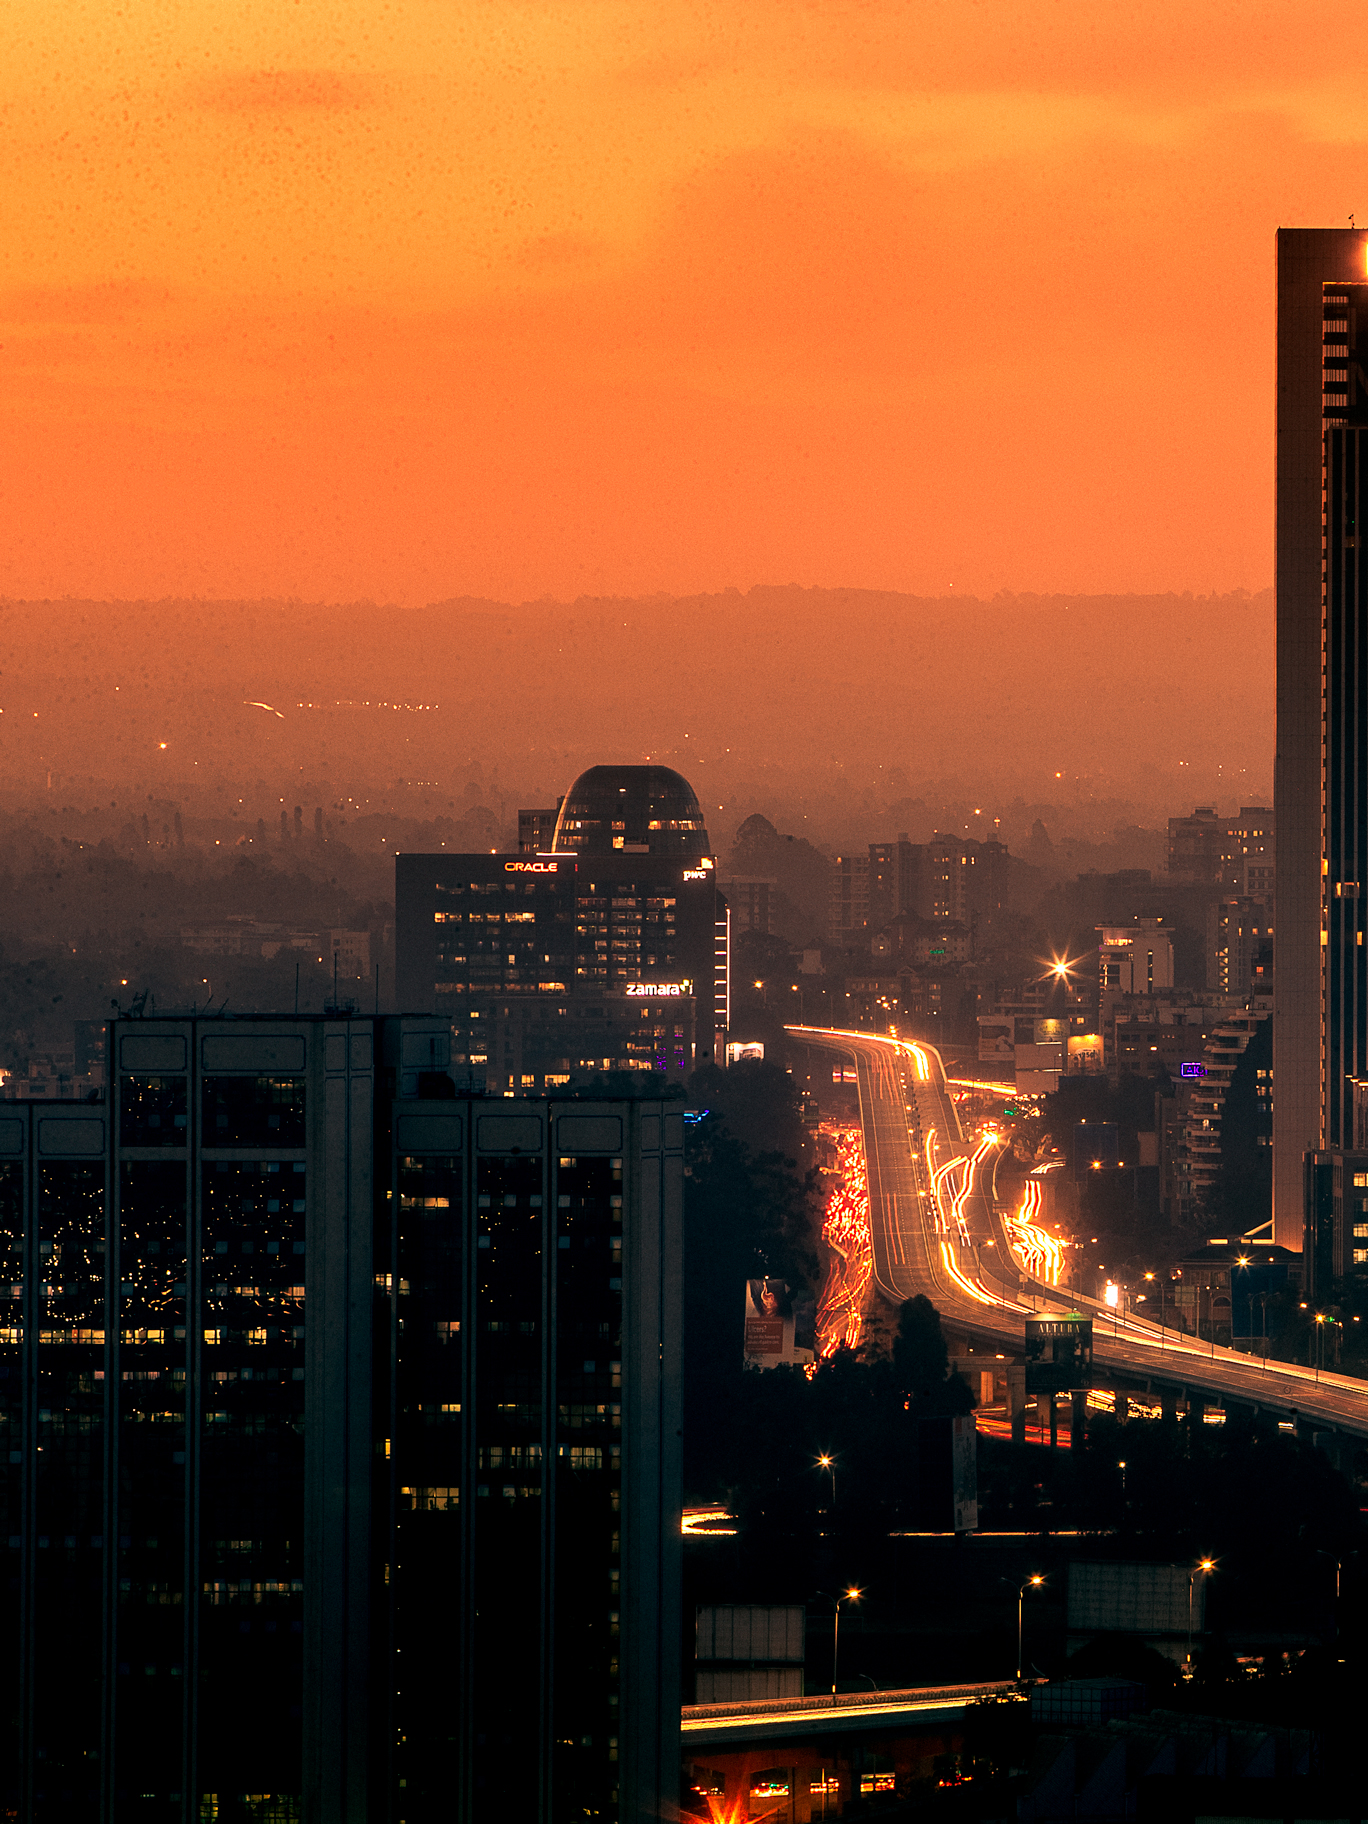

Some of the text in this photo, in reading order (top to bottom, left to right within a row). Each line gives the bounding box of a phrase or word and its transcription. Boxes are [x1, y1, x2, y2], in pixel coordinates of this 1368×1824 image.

[504, 862, 558, 872] ORACLE
[683, 870, 707, 881] pwc
[626, 983, 680, 996] zamara
[1039, 1323, 1080, 1333] ALTURA
